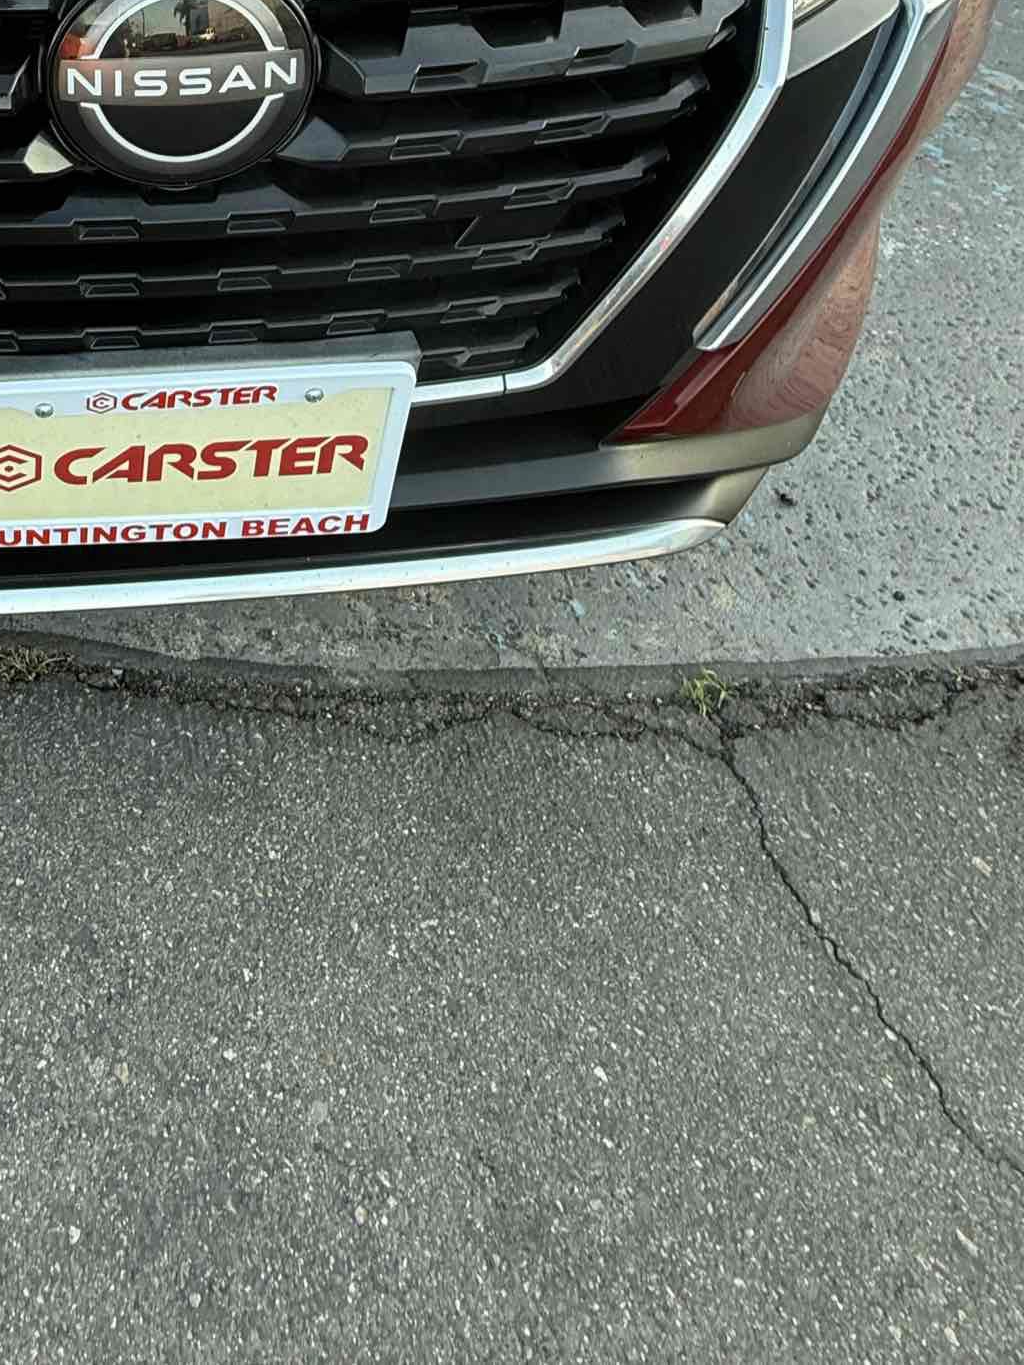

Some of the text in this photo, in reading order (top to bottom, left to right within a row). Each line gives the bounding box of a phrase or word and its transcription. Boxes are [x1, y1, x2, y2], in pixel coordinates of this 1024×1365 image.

[67, 58, 297, 97] NISSAN
[121, 385, 278, 411] CARSTER
[53, 434, 369, 485] CARSTER
[242, 513, 370, 538] BEACH
